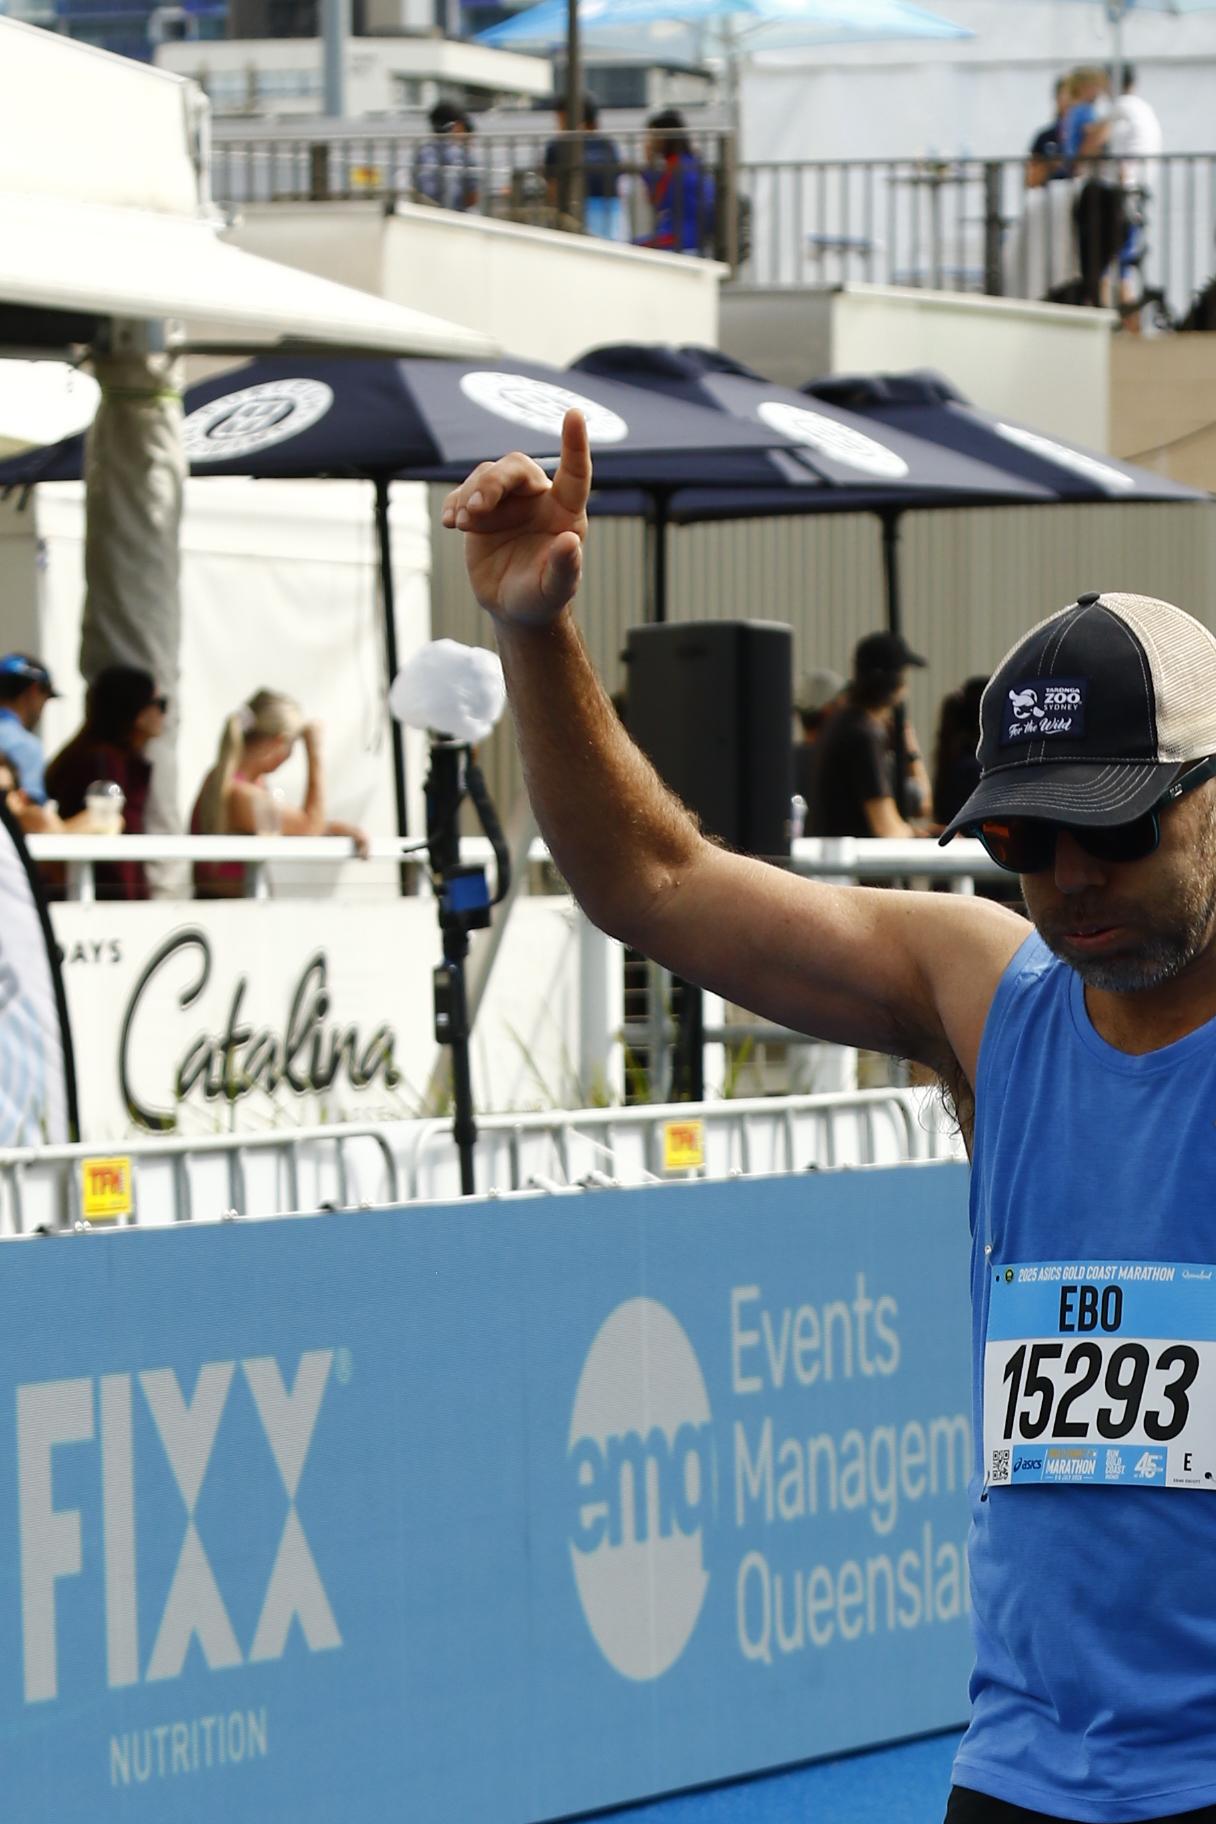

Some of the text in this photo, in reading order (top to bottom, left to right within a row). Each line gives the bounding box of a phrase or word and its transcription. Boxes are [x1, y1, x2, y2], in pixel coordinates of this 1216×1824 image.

[1044, 693, 1081, 704] ZOO
[1008, 717, 1072, 739] For the Wild
[119, 923, 399, 1133] Catalina
[1018, 1268, 1038, 1282] 2025
[1038, 1266, 1062, 1281] ASICS
[1063, 1266, 1086, 1280] GOLD
[1086, 1265, 1117, 1280] COAST
[1118, 1266, 1175, 1281] MARATHON
[1059, 1285, 1123, 1332] EBO
[731, 1272, 900, 1393] Events
[1003, 1342, 1200, 1441] 15293
[1046, 1459, 1096, 1475] MARATHON
[1184, 1453, 1193, 1471] E
[737, 1522, 970, 1665] Queensla
[110, 1708, 268, 1788] NUTRITION
